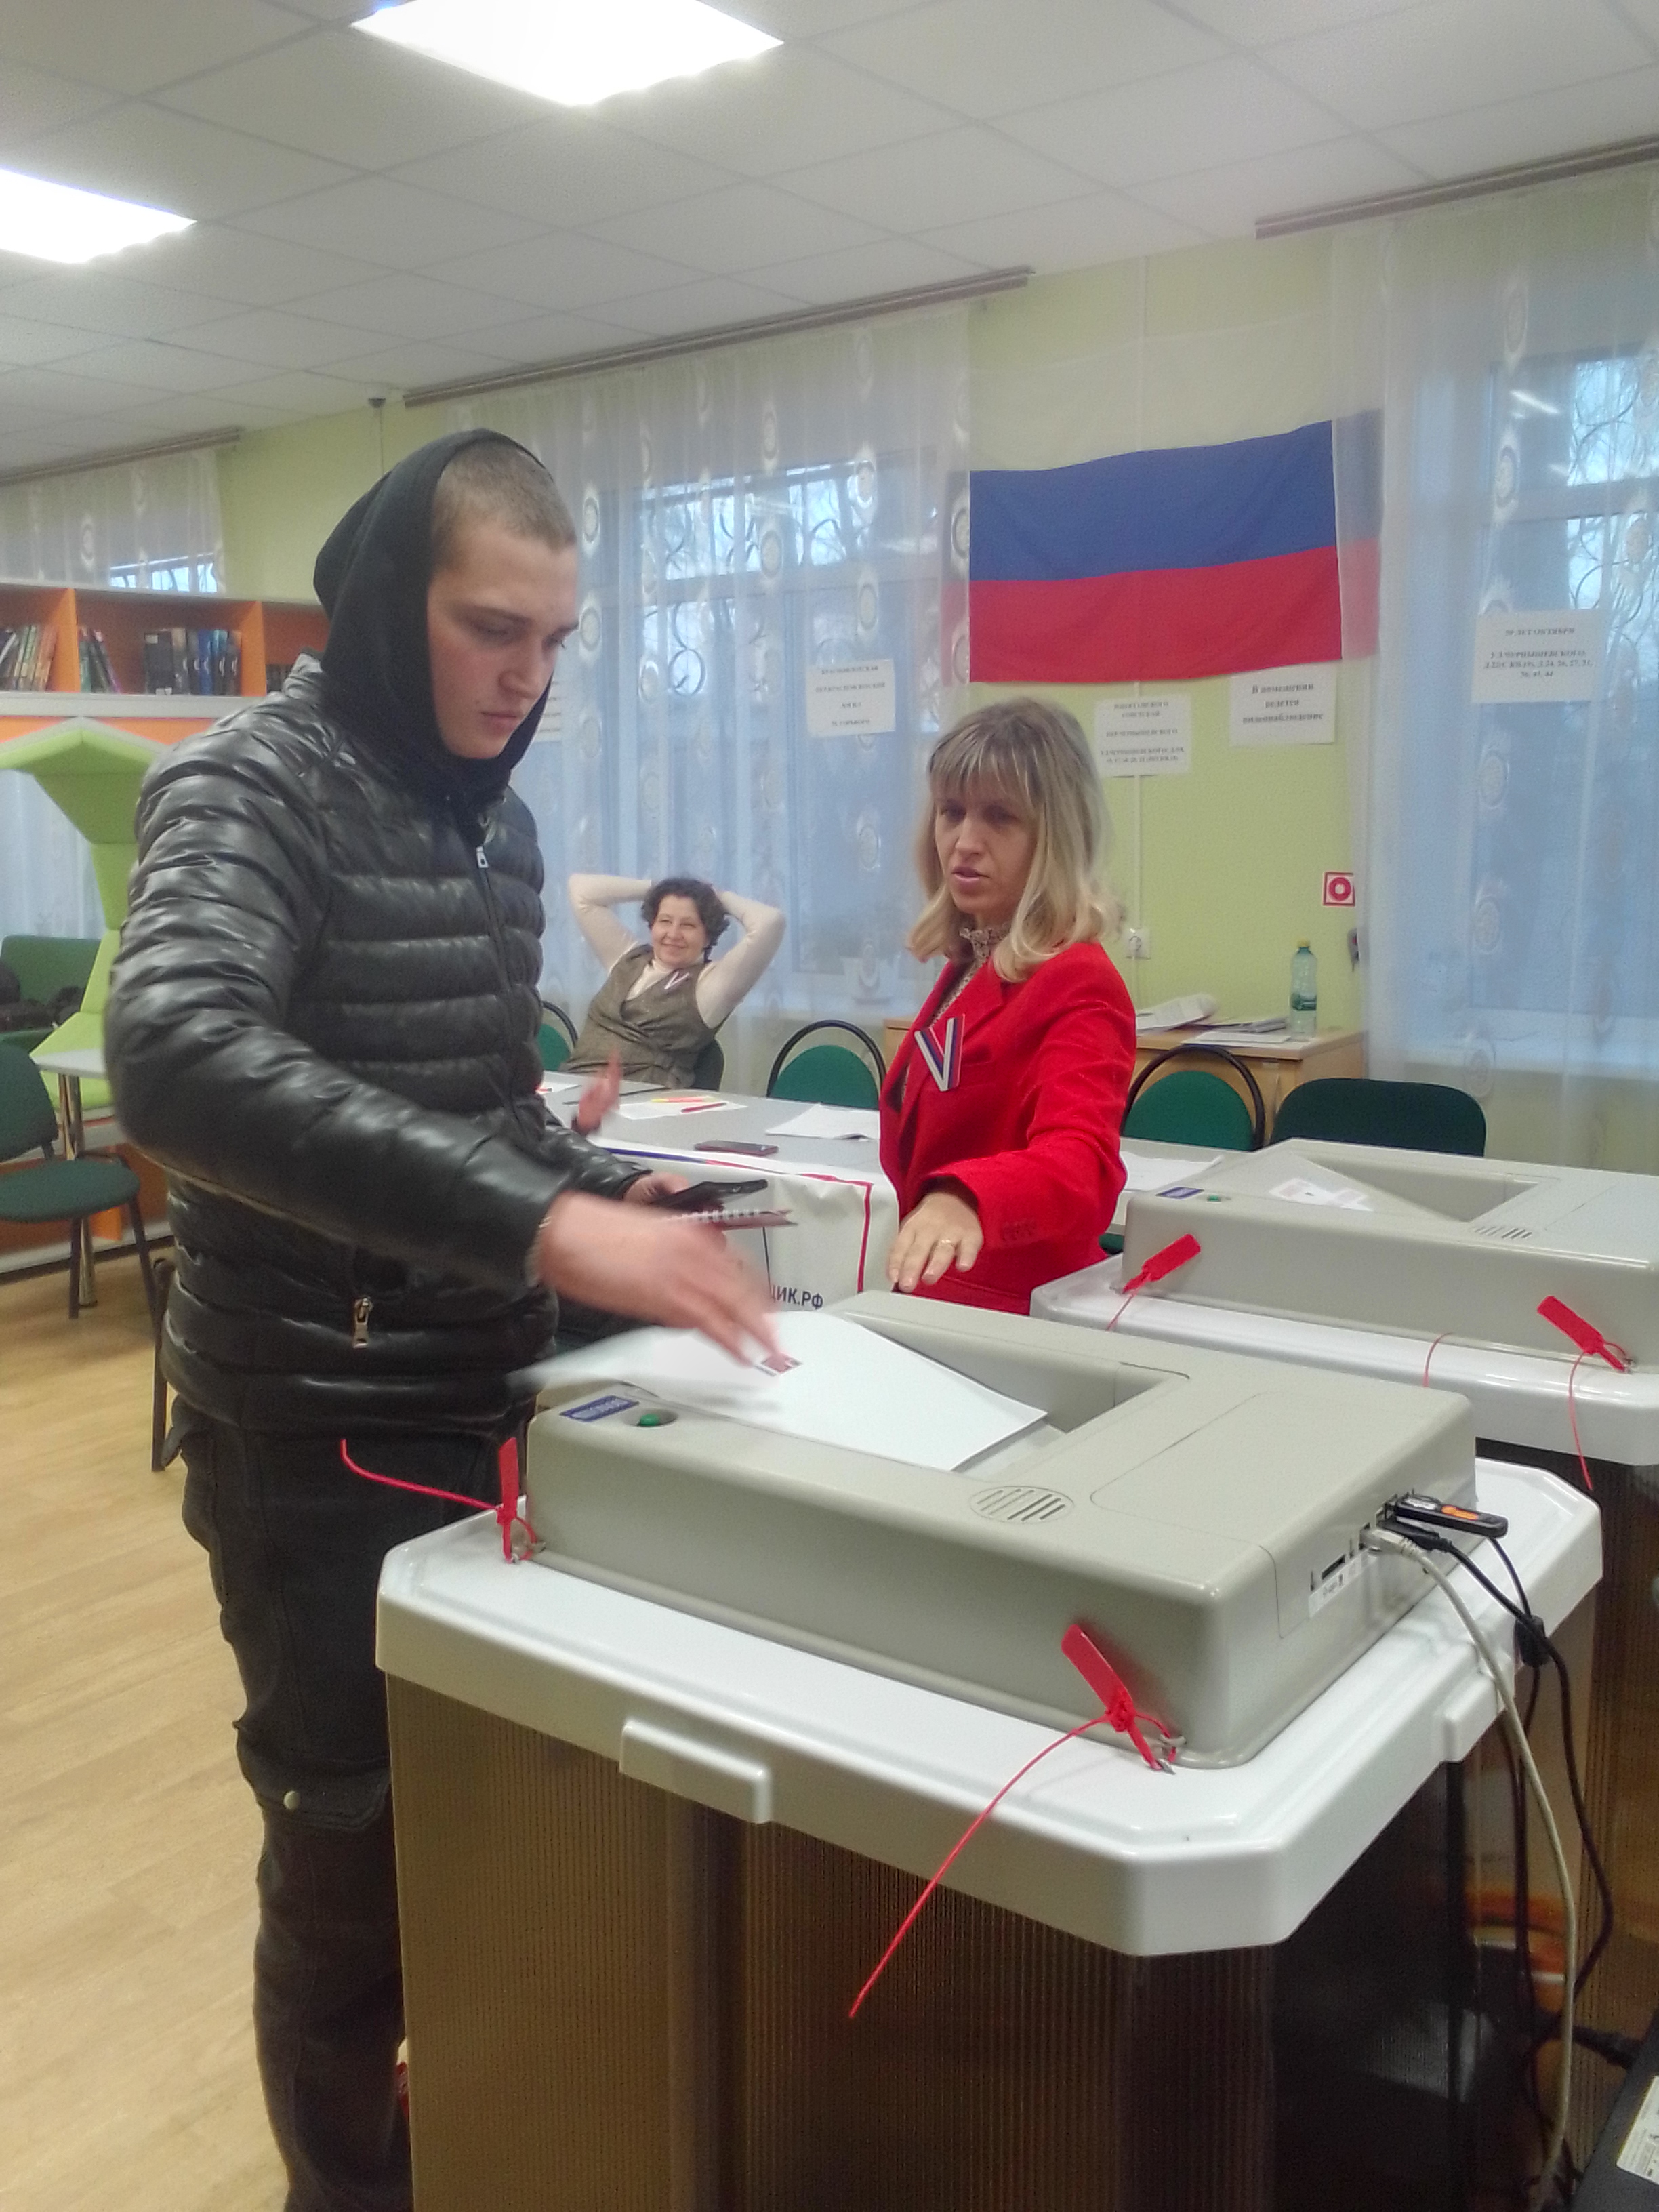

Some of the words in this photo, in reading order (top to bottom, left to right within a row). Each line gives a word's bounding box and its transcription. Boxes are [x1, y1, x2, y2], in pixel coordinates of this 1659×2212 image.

[1252, 684, 1259, 695] В
[1261, 683, 1314, 694] помещении
[1265, 699, 1300, 708] ведется
[1242, 713, 1324, 724] видеонаблюдение
